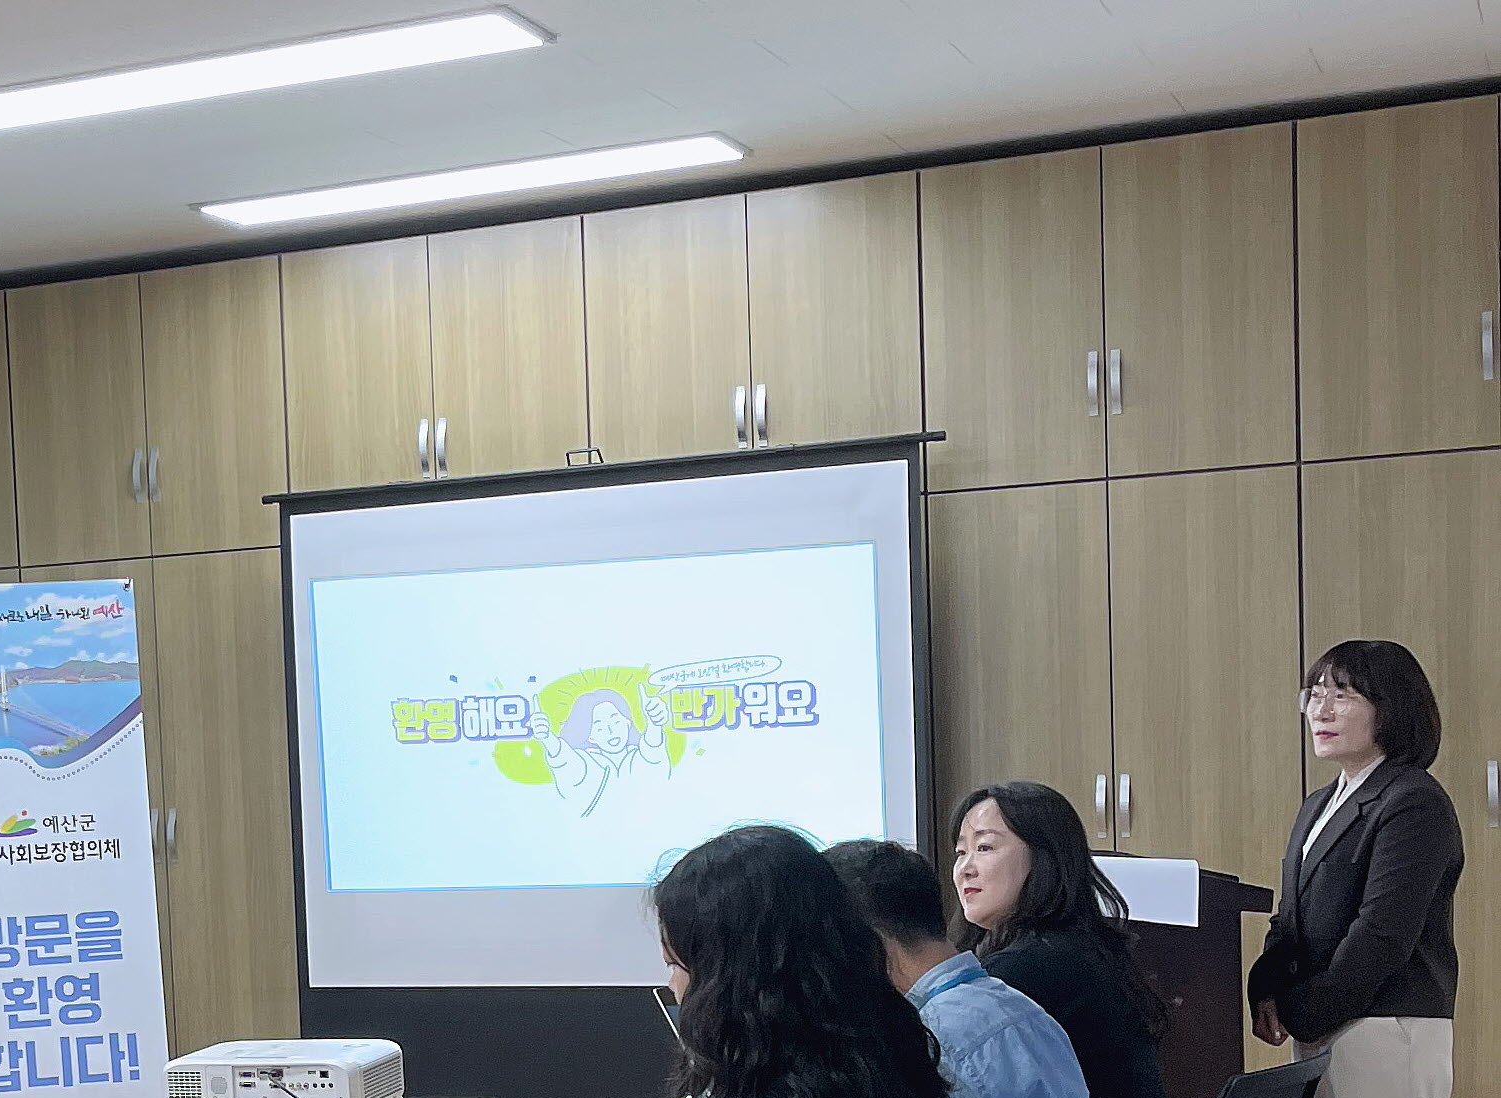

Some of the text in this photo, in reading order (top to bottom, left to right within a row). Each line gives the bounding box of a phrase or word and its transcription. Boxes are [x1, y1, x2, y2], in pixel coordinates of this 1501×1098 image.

[391, 695, 533, 744] 환영 해요
[671, 680, 819, 732] 반가 워요
[42, 814, 96, 834] 예산군
[1, 972, 102, 1030] 환영
